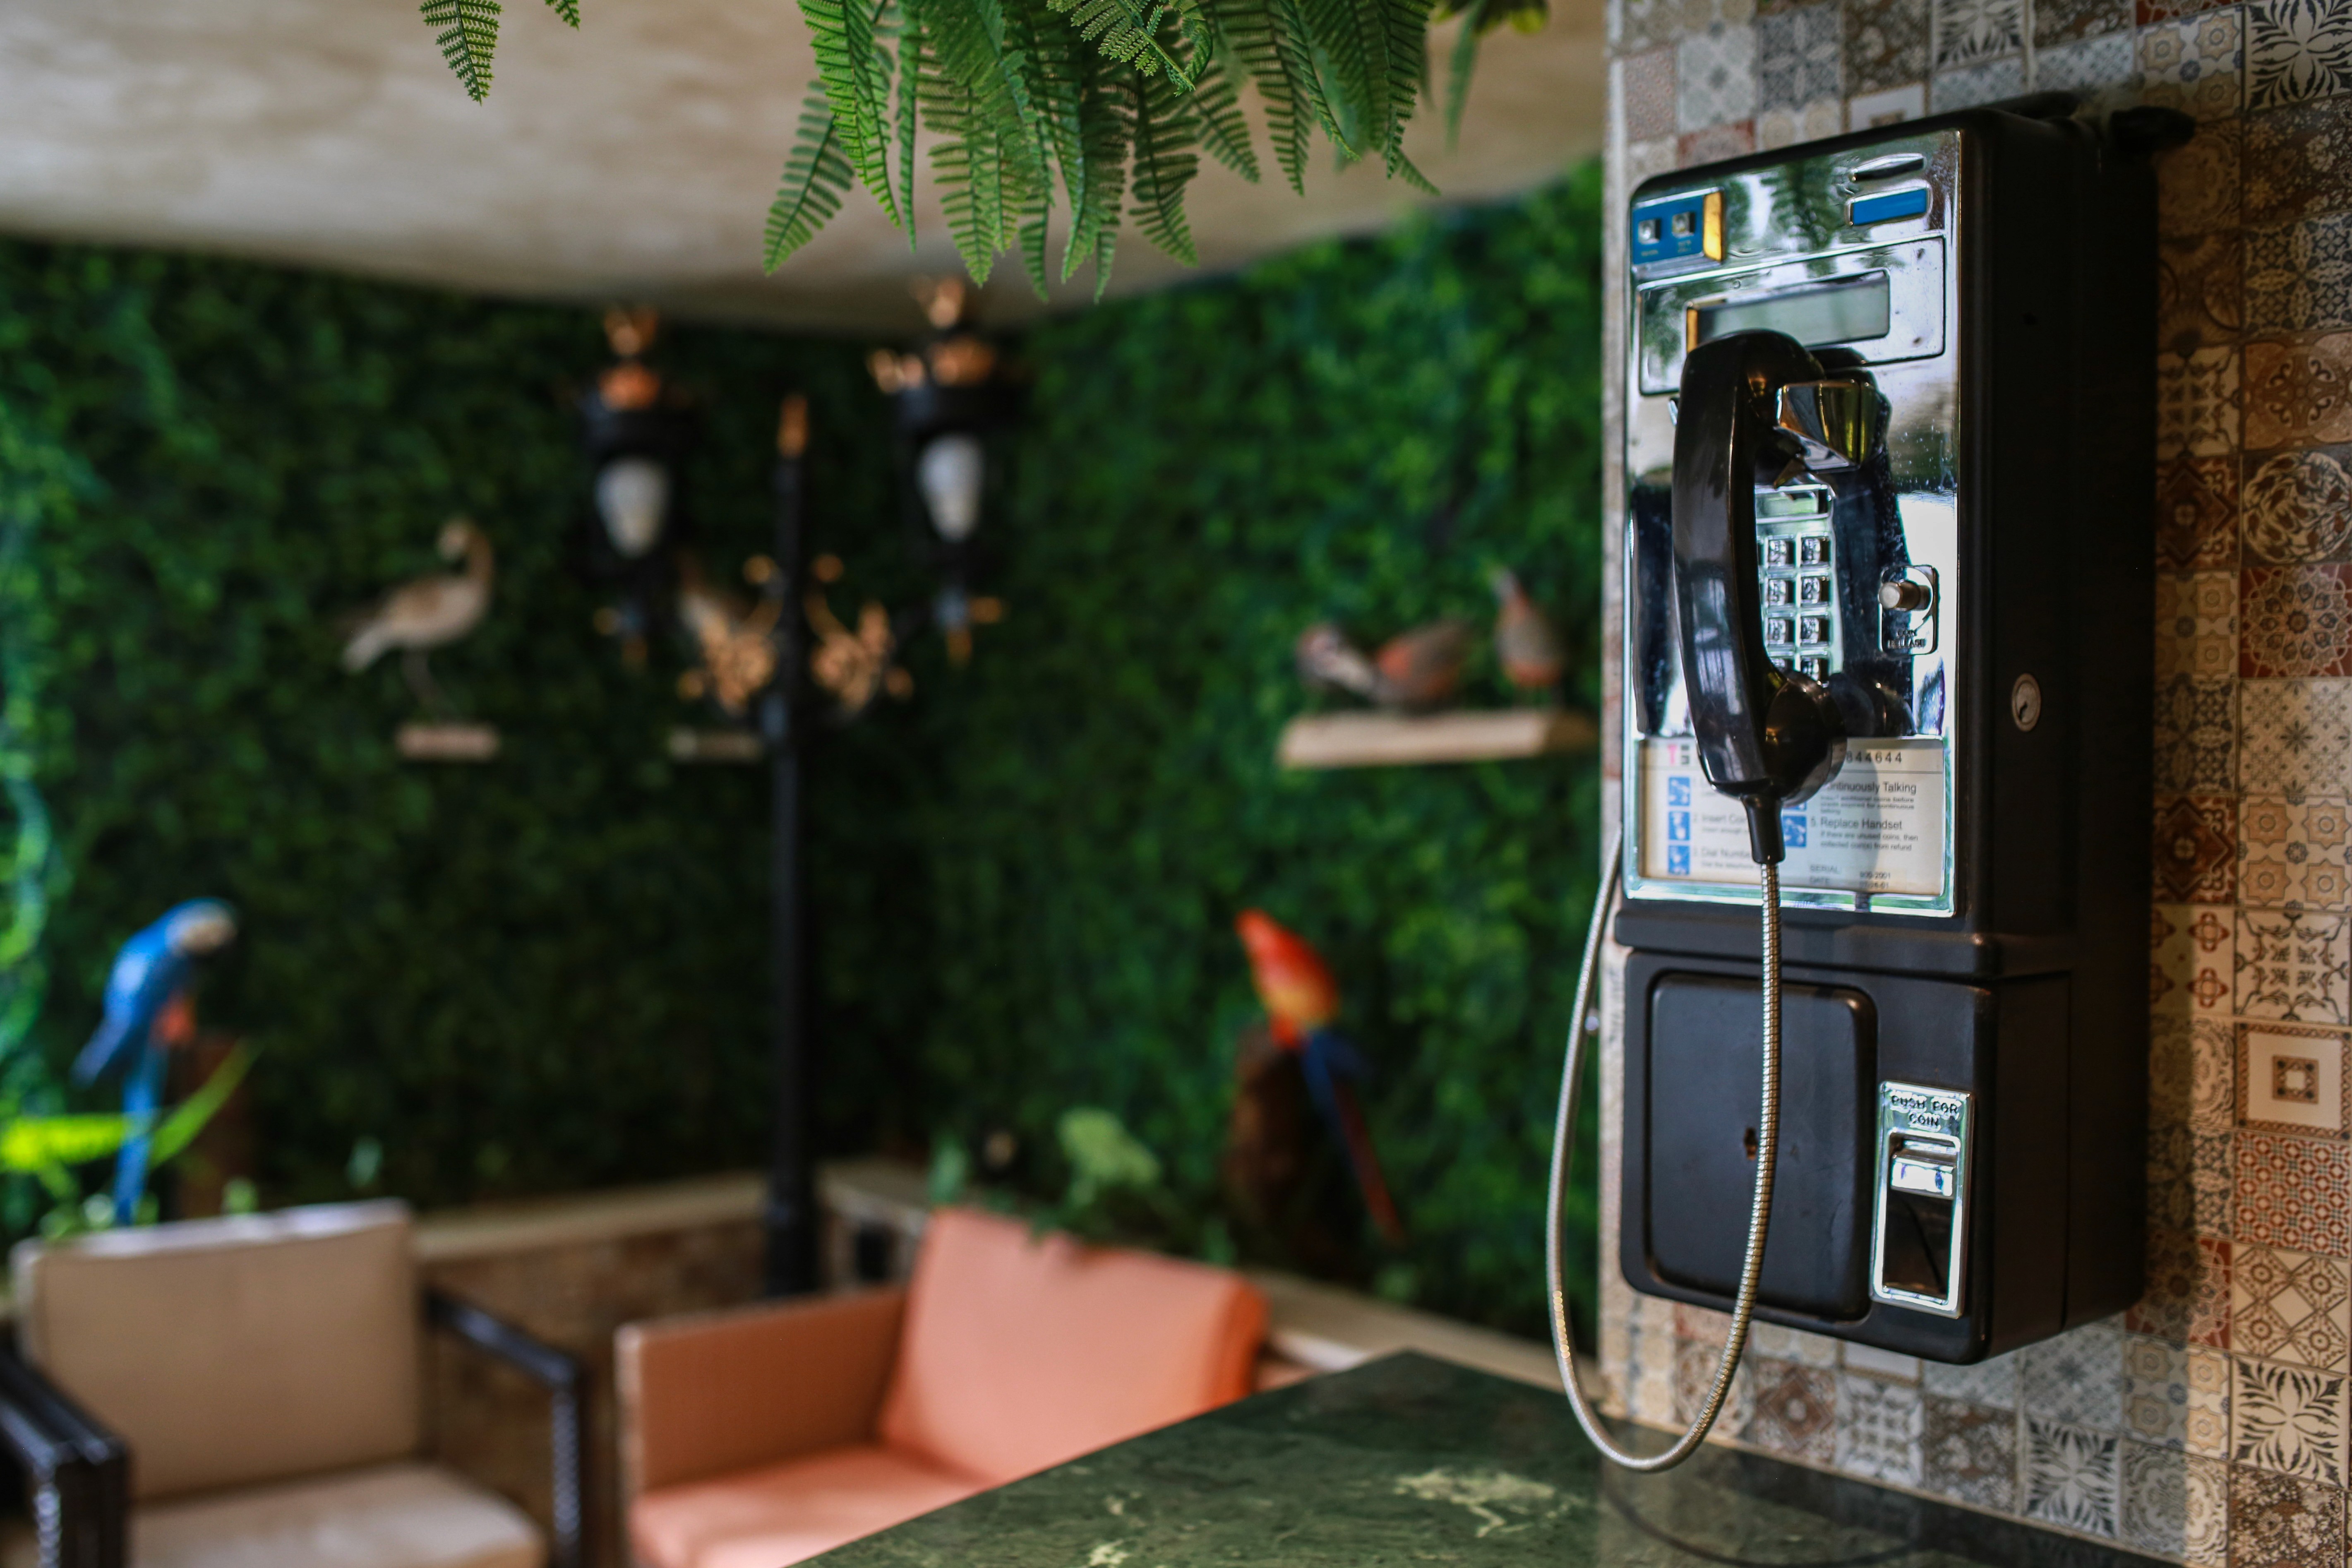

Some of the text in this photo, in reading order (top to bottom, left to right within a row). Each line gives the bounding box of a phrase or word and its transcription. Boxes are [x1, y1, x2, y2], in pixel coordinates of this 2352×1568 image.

[1882, 781, 1917, 795] Talking
[1821, 817, 1858, 829] Replace
[1862, 818, 1903, 830] Handset
[1891, 843, 1912, 852] refund
[1891, 1095, 1959, 1114] PUSH FOR
[1908, 1113, 1940, 1127] COIN
